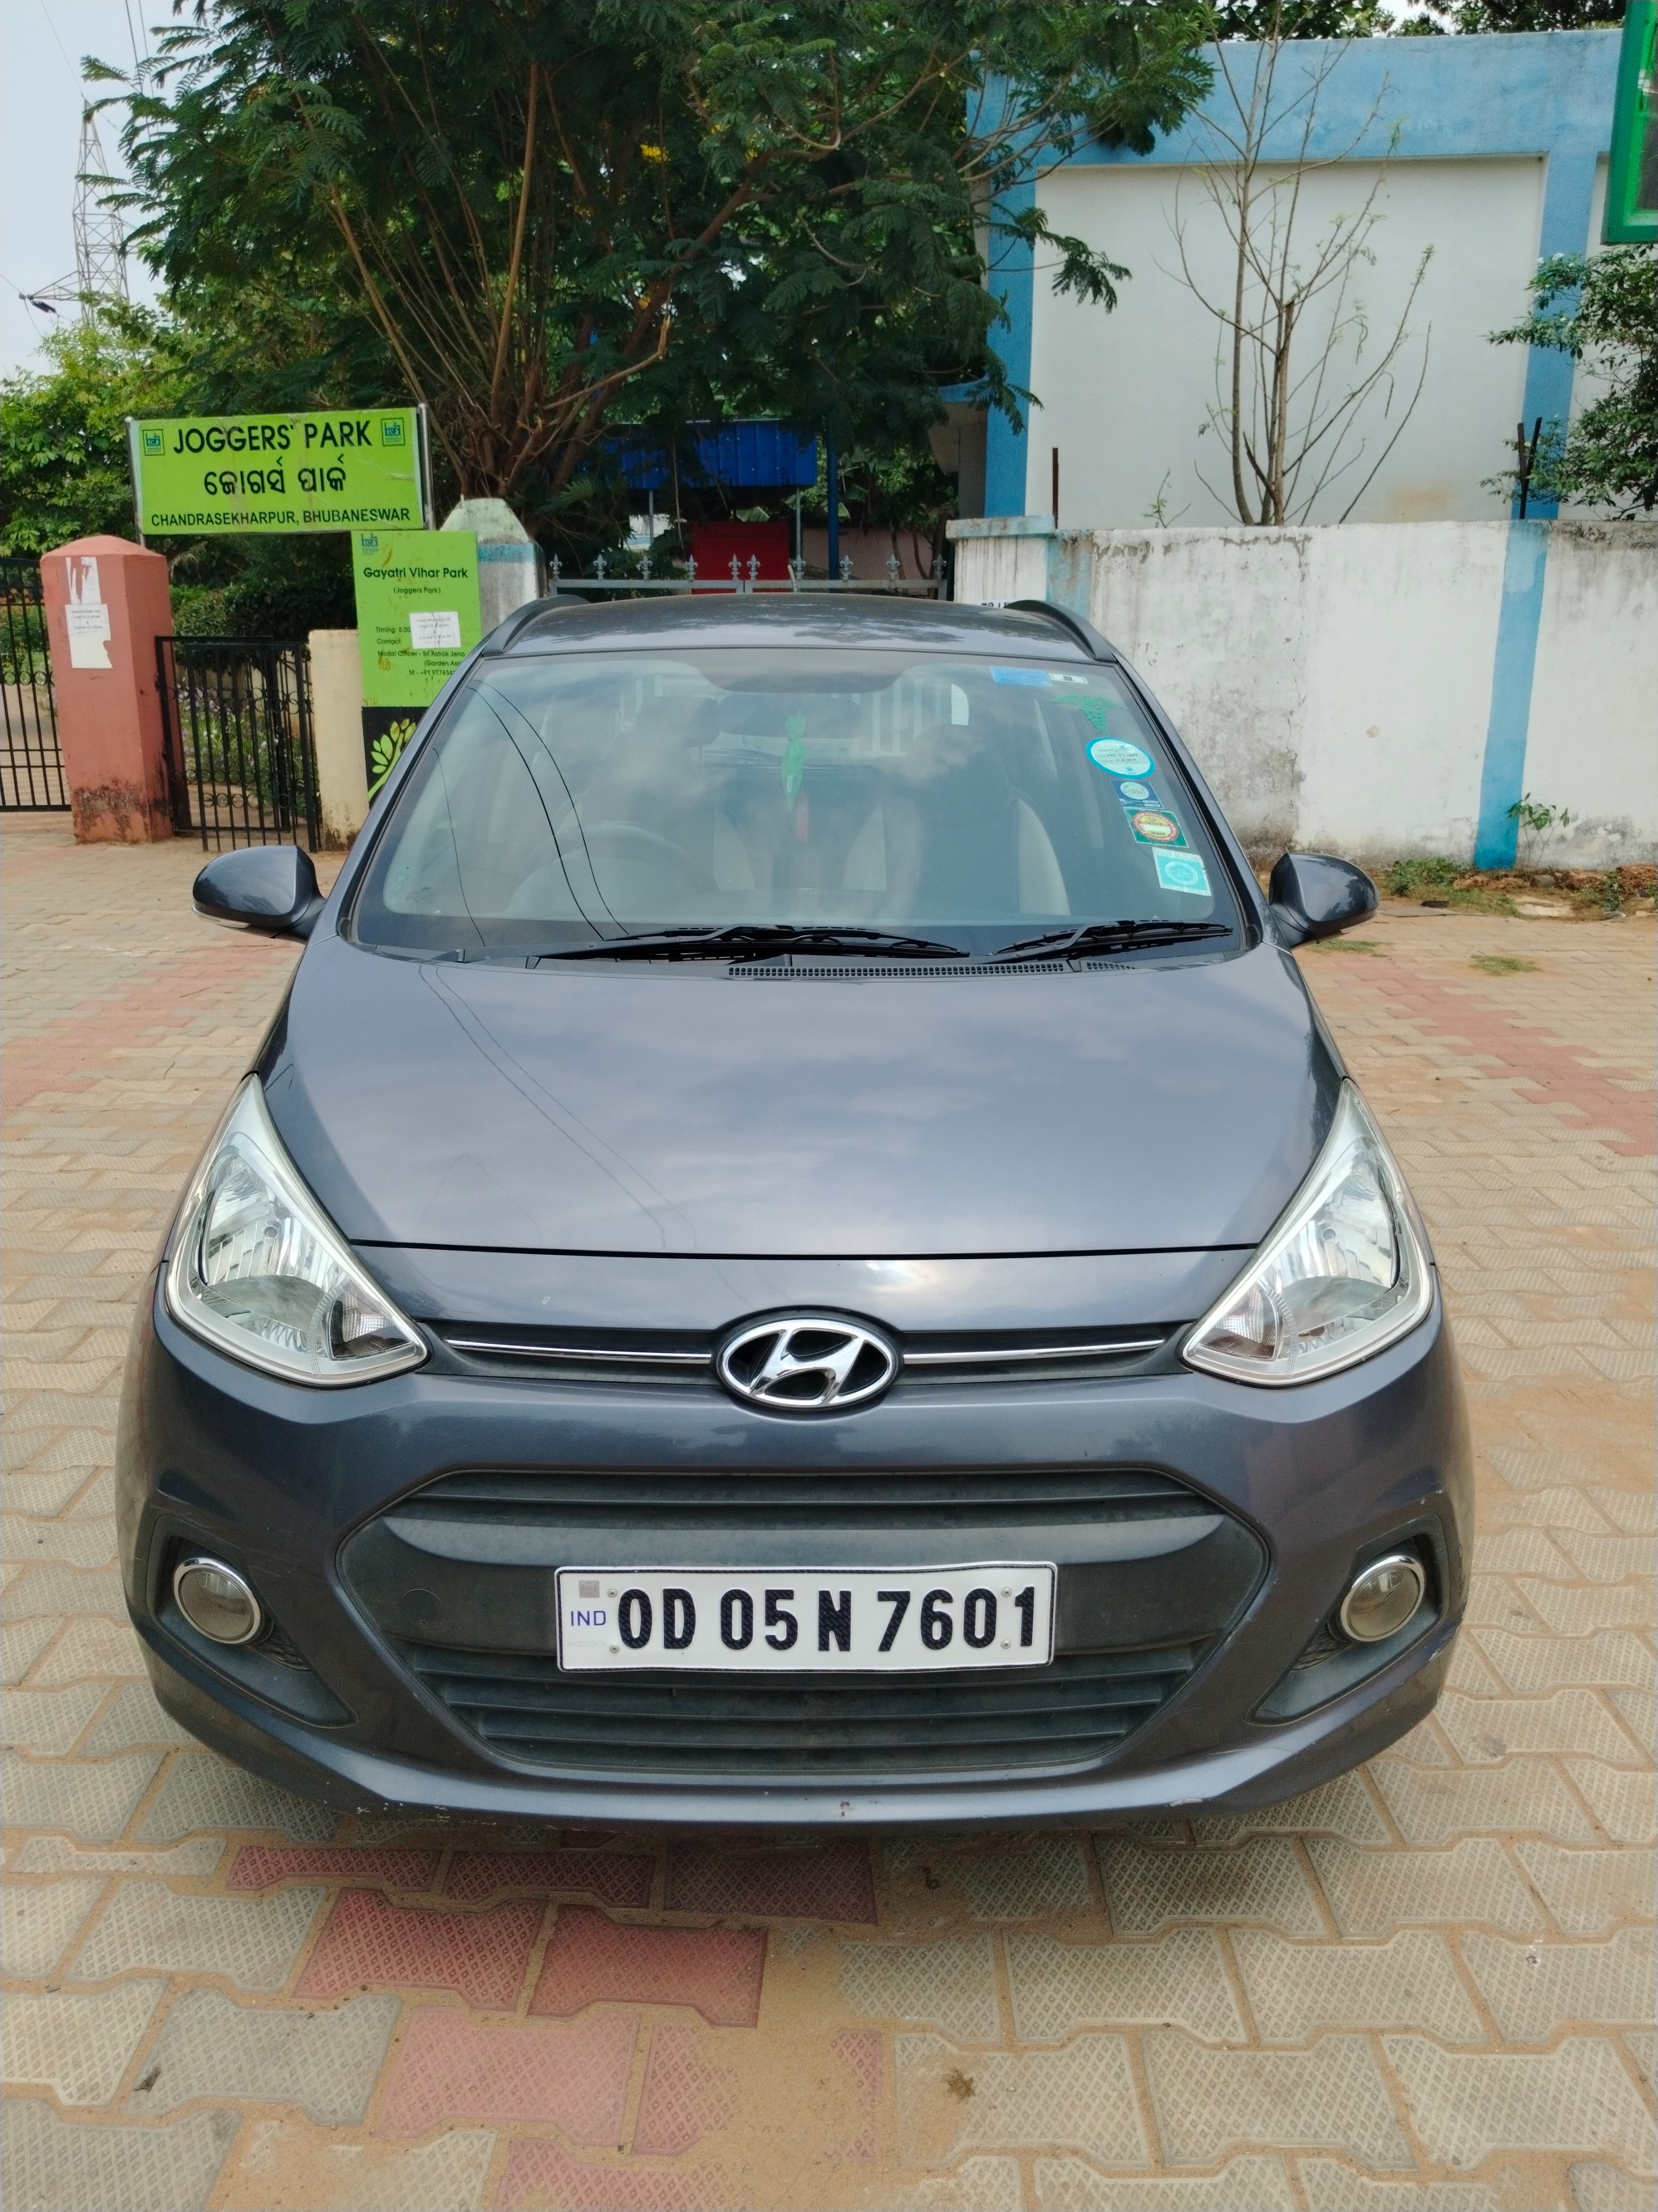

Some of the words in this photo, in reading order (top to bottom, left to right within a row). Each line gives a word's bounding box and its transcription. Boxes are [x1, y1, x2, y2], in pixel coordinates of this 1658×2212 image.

[305, 421, 373, 449] PARK
[204, 456, 286, 496] ଜୋଗର୍ସ
[298, 453, 347, 492] ପାର୍କ
[151, 511, 300, 527] CHANDRASEKHARPUR,
[303, 508, 410, 523] BHUBANESWAR
[364, 567, 406, 580] Gayatri
[409, 567, 440, 578] Vihar
[443, 567, 468, 579] Park
[570, 1610, 607, 1626] IND
[618, 1588, 696, 1649] OD
[719, 1588, 798, 1652] 05
[818, 1589, 852, 1652] N
[877, 1586, 1035, 1652] 7601
